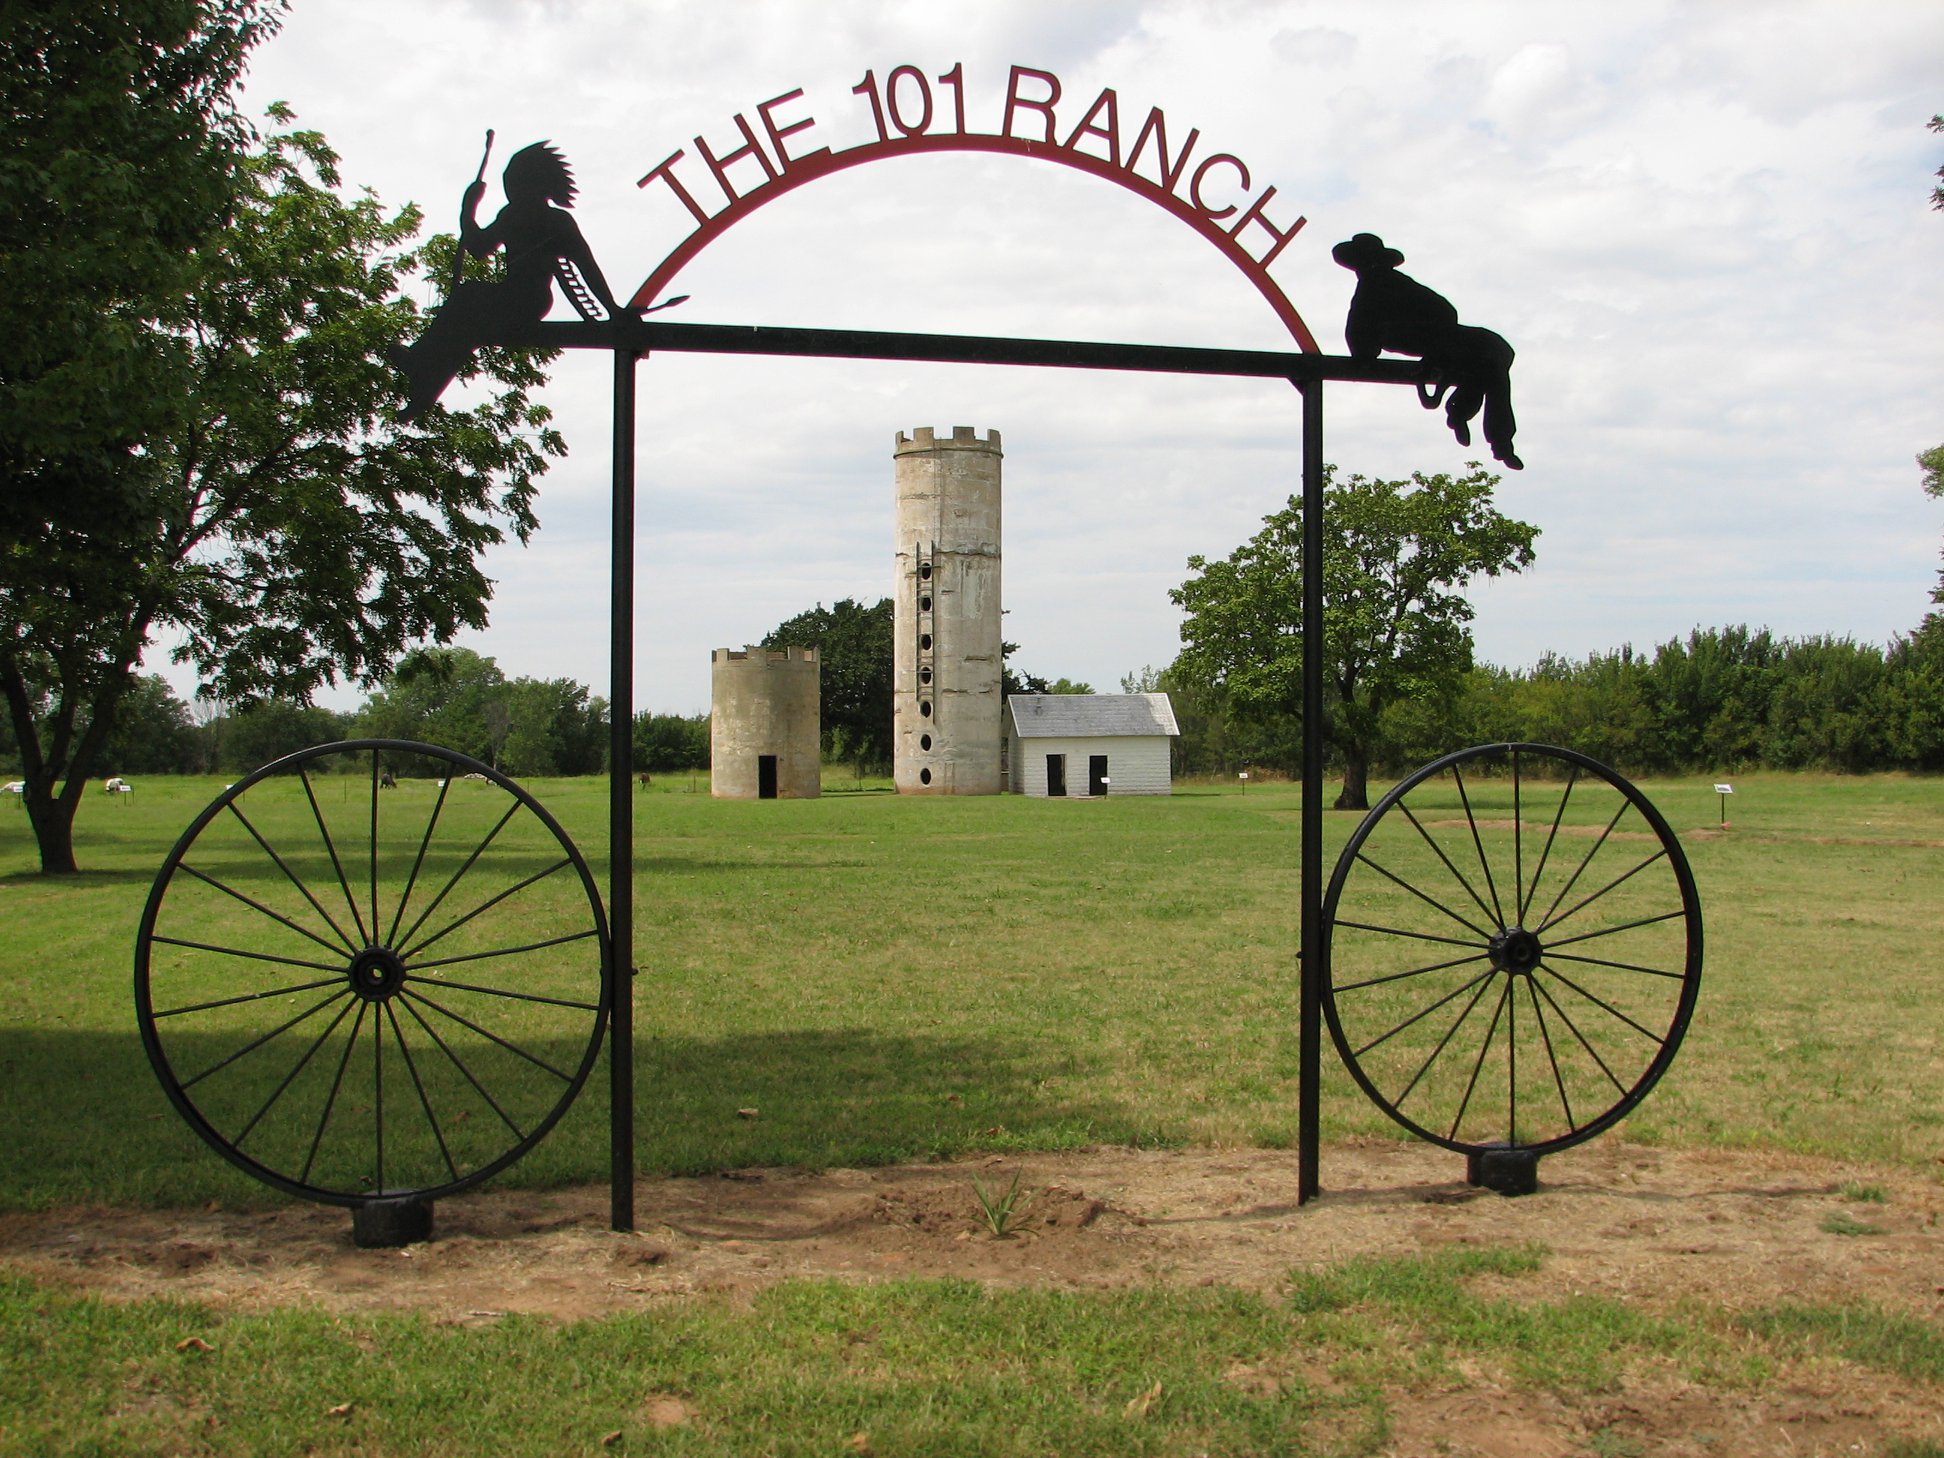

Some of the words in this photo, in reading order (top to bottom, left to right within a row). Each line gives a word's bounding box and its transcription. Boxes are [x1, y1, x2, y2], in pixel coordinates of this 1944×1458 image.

[637, 88, 831, 227] THE
[852, 62, 966, 141] 101
[1001, 65, 1307, 271] RANCH
